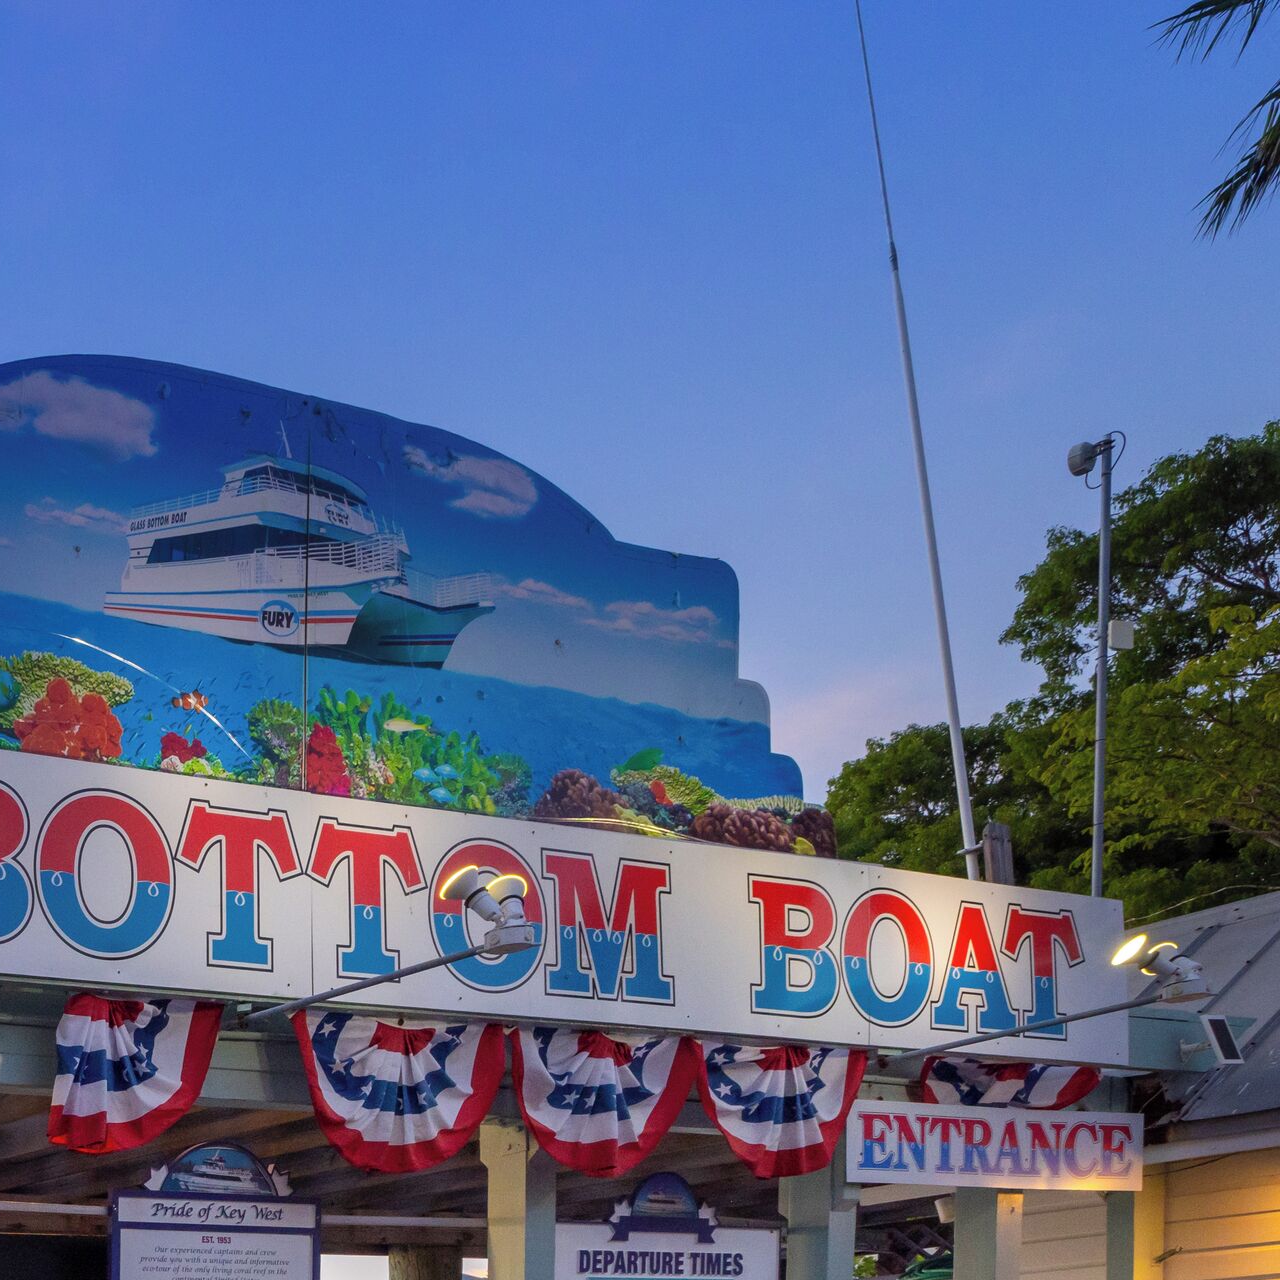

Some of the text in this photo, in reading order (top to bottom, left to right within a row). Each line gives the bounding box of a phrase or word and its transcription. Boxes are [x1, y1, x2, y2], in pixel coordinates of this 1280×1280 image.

[130, 512, 188, 532] GLASS BOTTOM BOAT
[262, 610, 293, 628] FURY
[748, 873, 1084, 1040] BOAT
[857, 1112, 1135, 1178] ENTRANCE
[152, 1202, 284, 1224] Pride of Key West
[140, 1256, 167, 1264] provide
[578, 1250, 743, 1276] DEPARTURE TIMES
